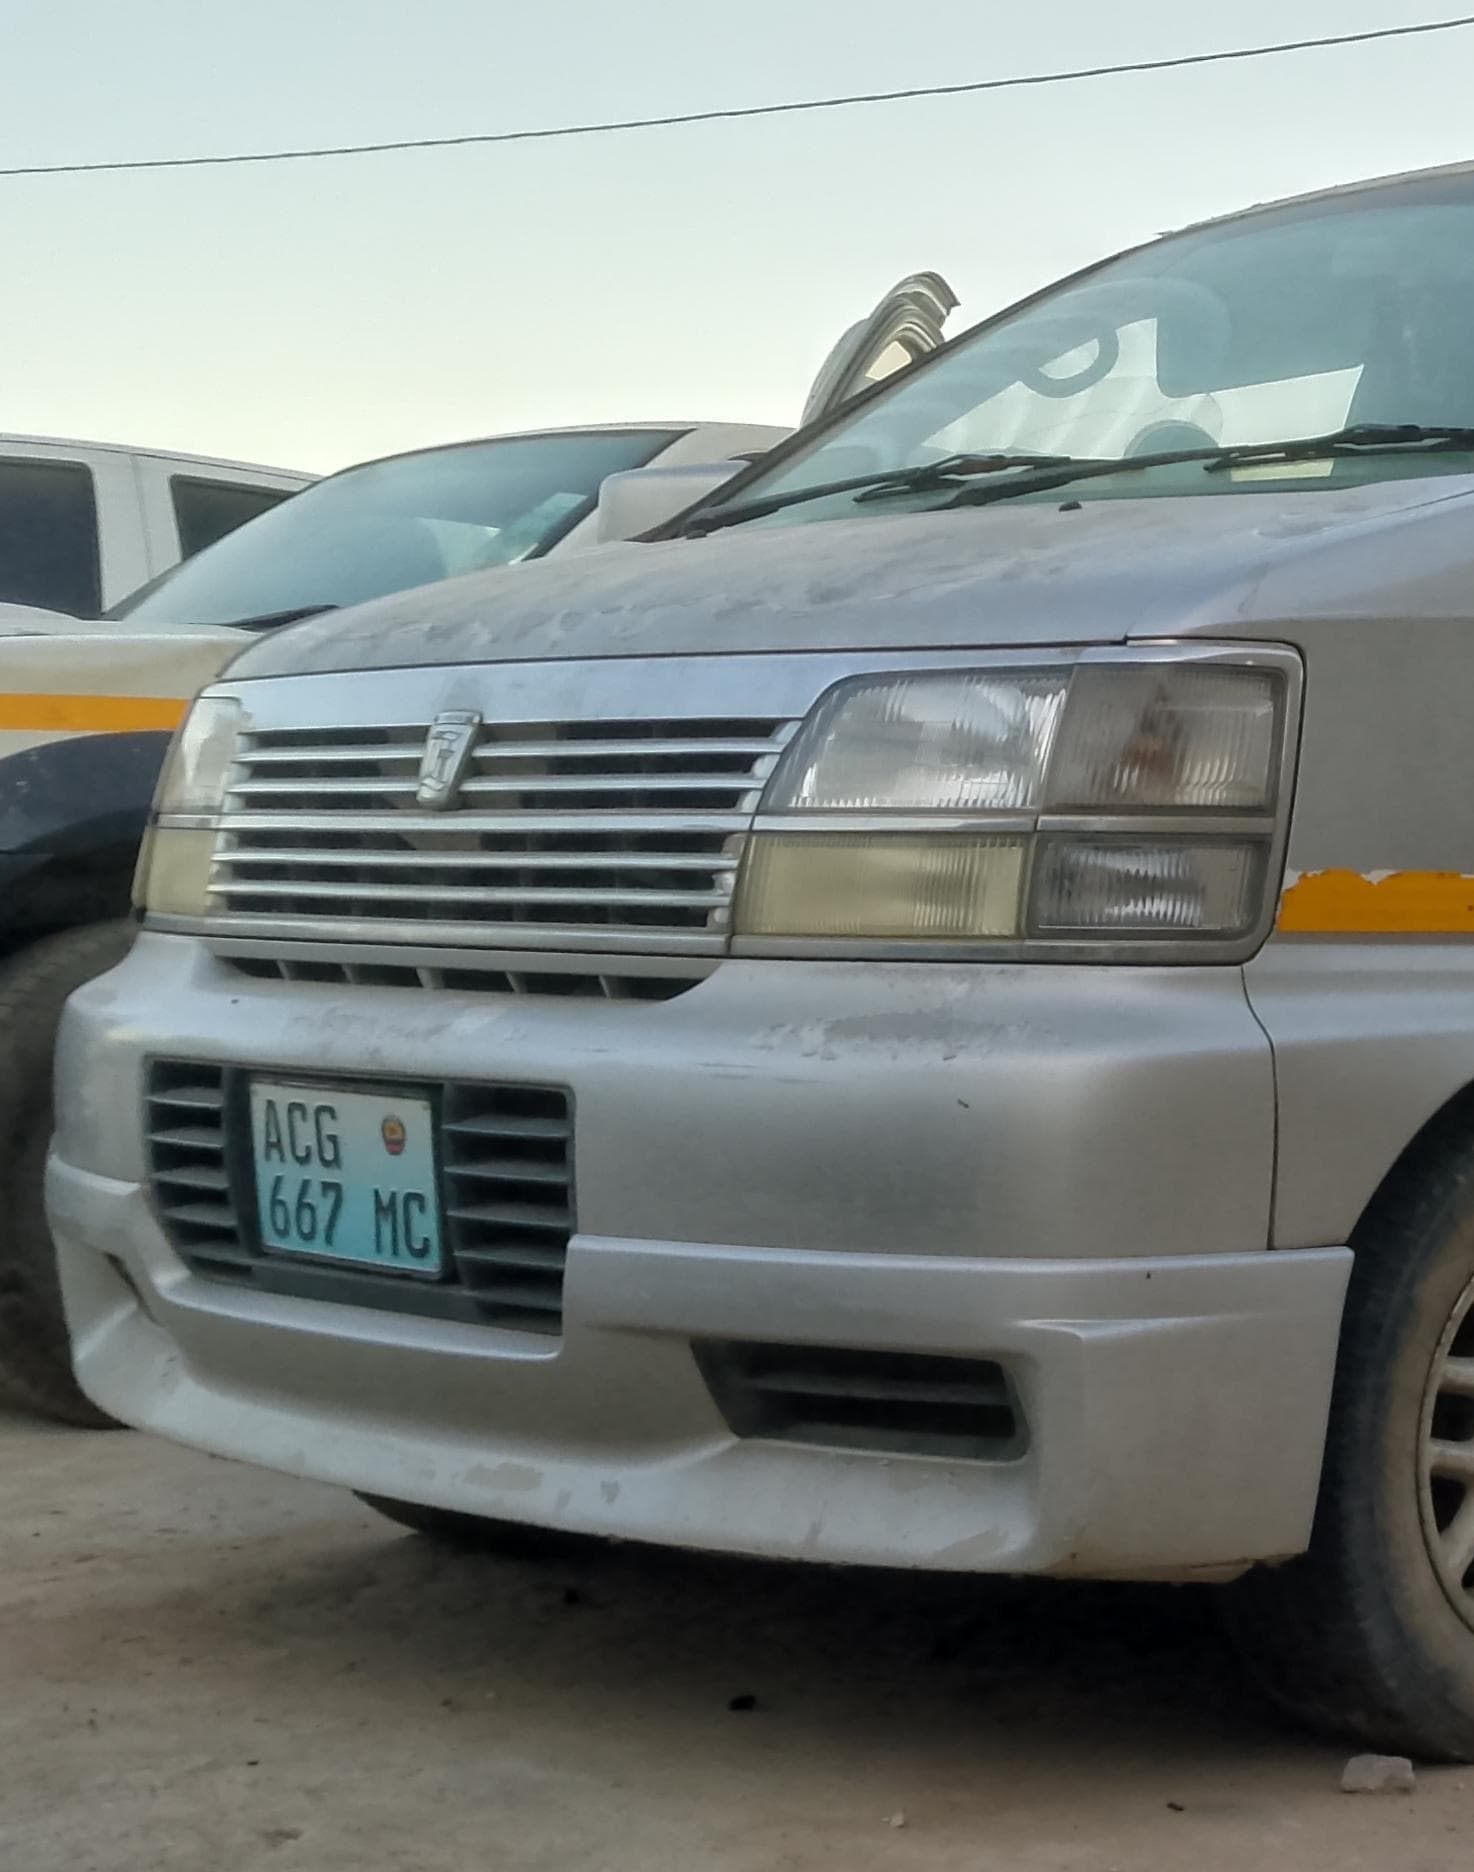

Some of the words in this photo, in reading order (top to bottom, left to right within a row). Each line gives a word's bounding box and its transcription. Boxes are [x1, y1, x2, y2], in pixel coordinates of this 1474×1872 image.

[264, 1098, 342, 1169] ACG
[269, 1175, 344, 1247] 667
[373, 1187, 431, 1259] MC
